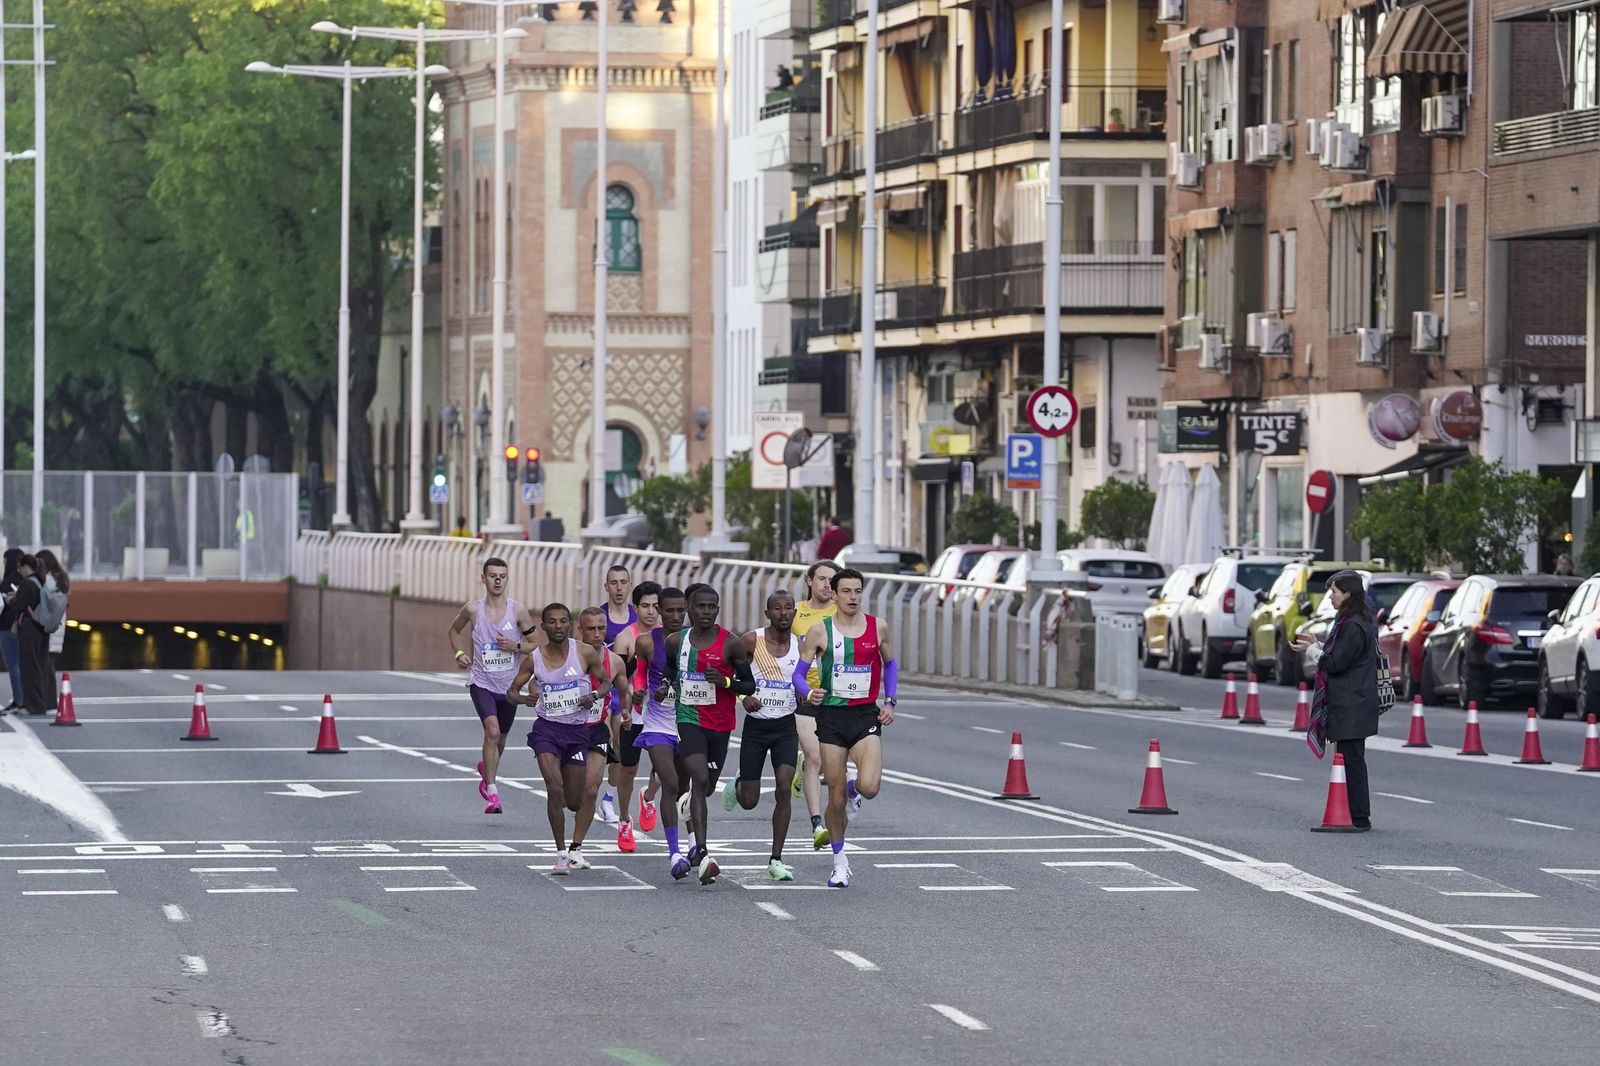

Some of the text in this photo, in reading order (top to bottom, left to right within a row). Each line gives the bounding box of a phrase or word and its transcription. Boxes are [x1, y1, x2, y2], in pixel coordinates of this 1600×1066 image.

[1239, 415, 1297, 430] TINTE
[1011, 439, 1034, 468] P
[484, 656, 512, 666] MATEUSZ
[847, 683, 857, 691] 49
[685, 690, 708, 698] PACER
